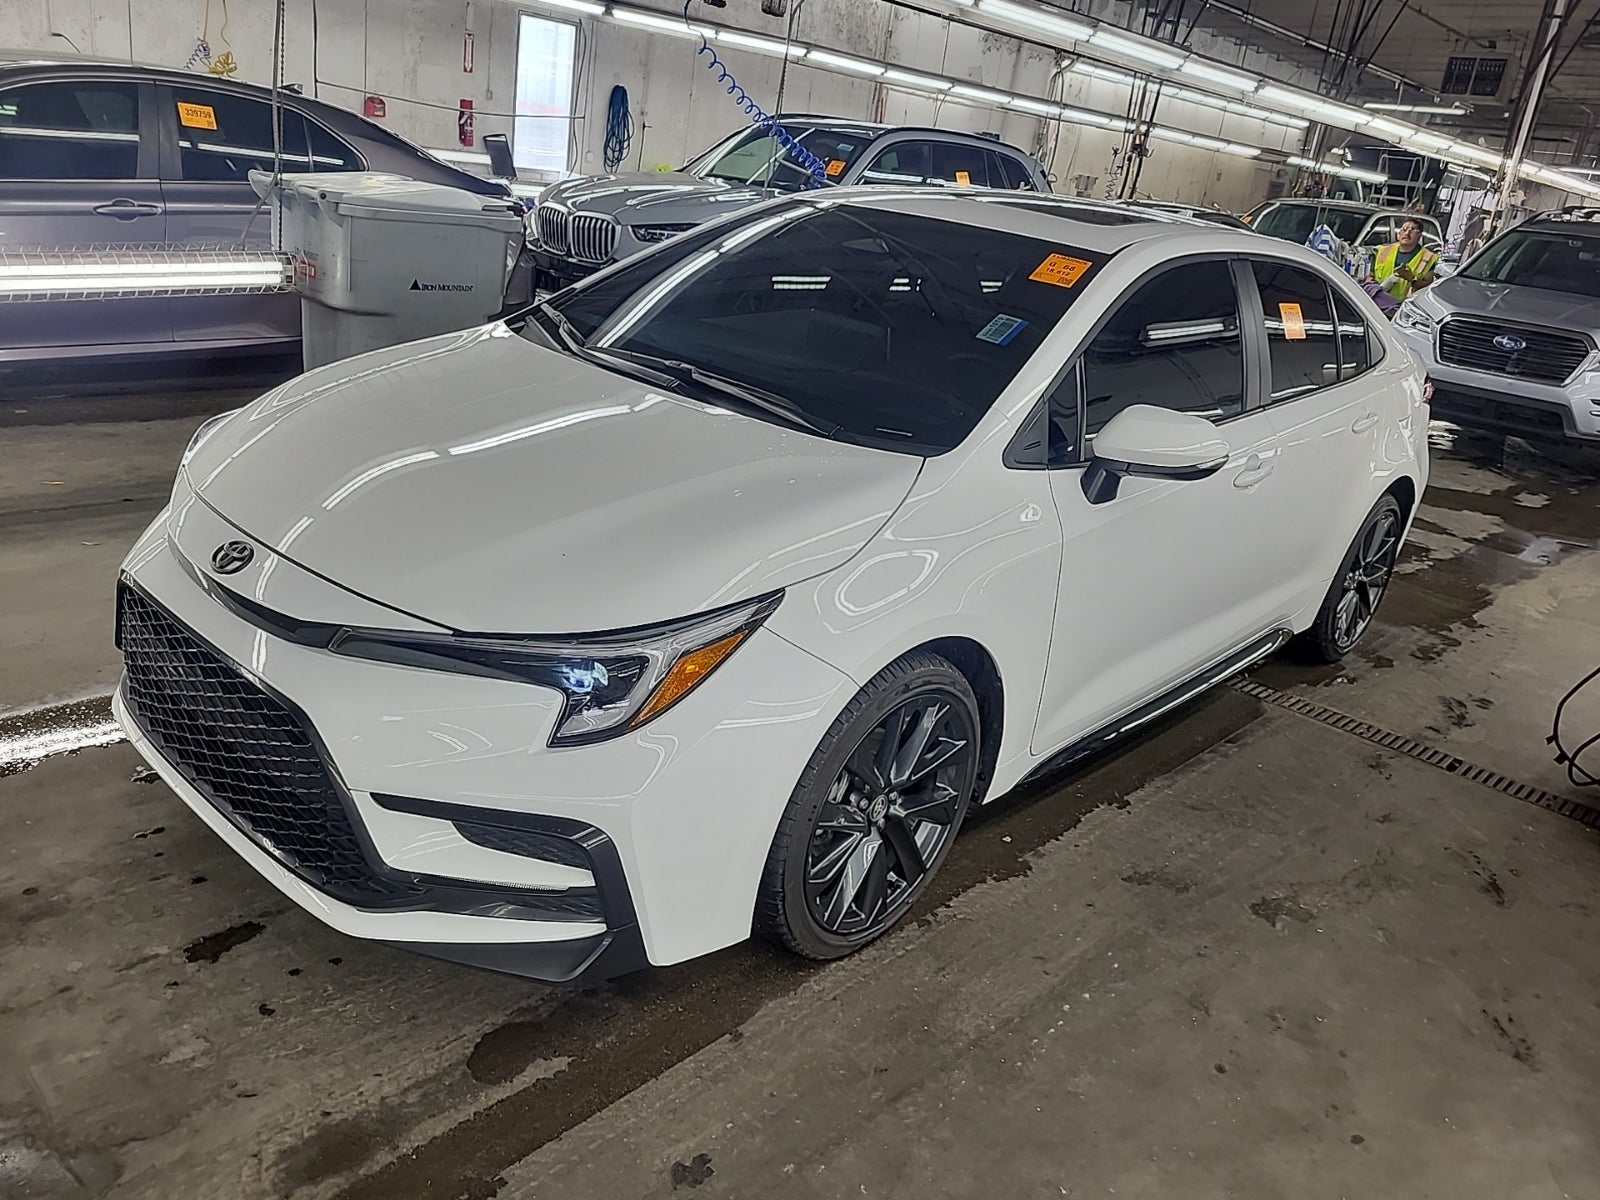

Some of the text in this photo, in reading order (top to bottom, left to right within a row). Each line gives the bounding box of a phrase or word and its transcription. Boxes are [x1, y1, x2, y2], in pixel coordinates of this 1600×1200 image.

[184, 108, 212, 118] 339759
[1062, 264, 1076, 272] 68
[421, 283, 472, 292] IRON MOUNTAIN
